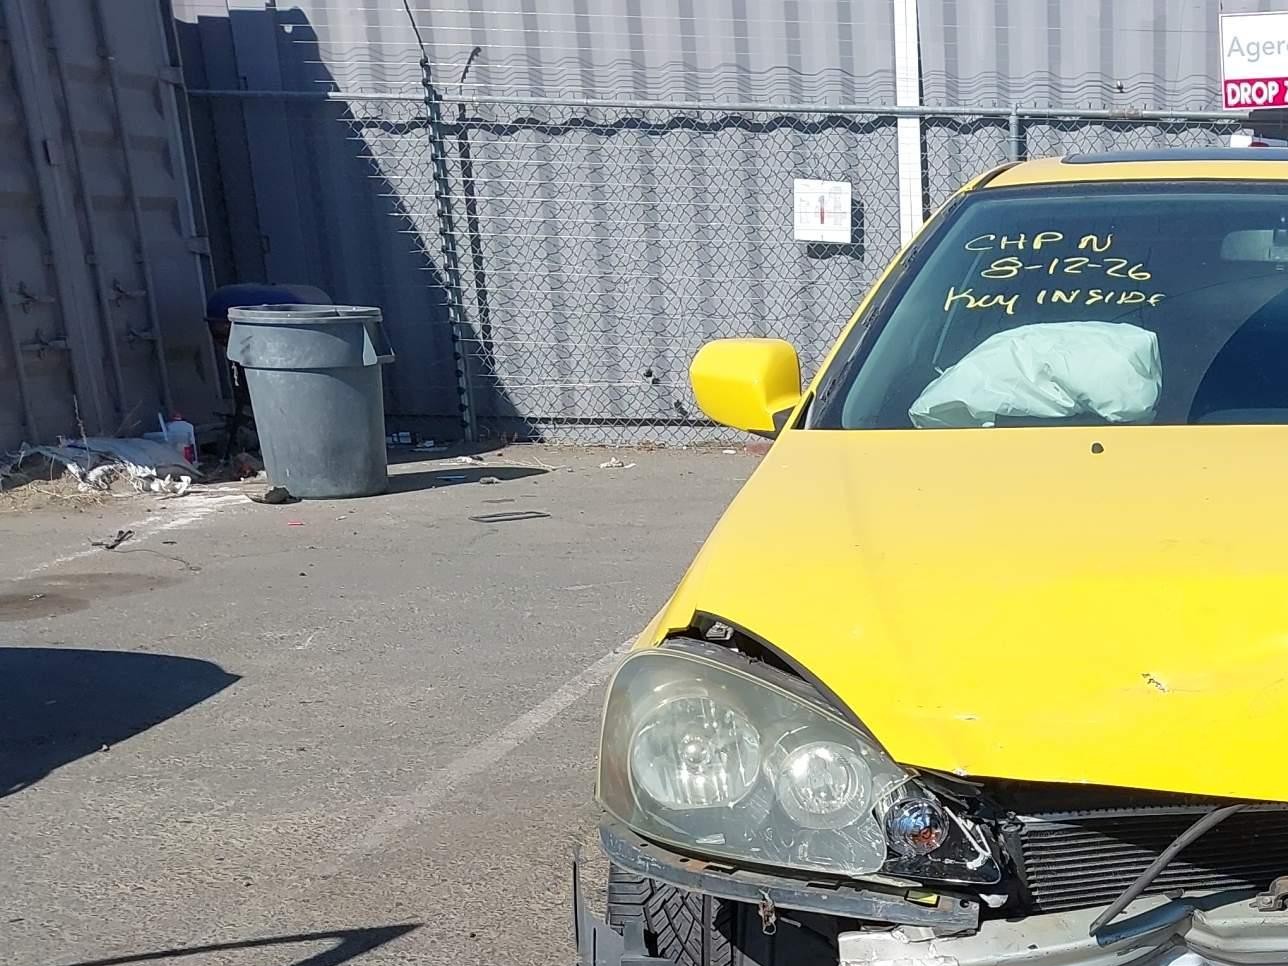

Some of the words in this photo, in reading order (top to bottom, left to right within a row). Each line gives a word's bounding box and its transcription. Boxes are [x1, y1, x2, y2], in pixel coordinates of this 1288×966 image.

[1226, 80, 1279, 106] DROP
[965, 231, 1064, 250] CHP
[980, 256, 1151, 280] 8-12-26
